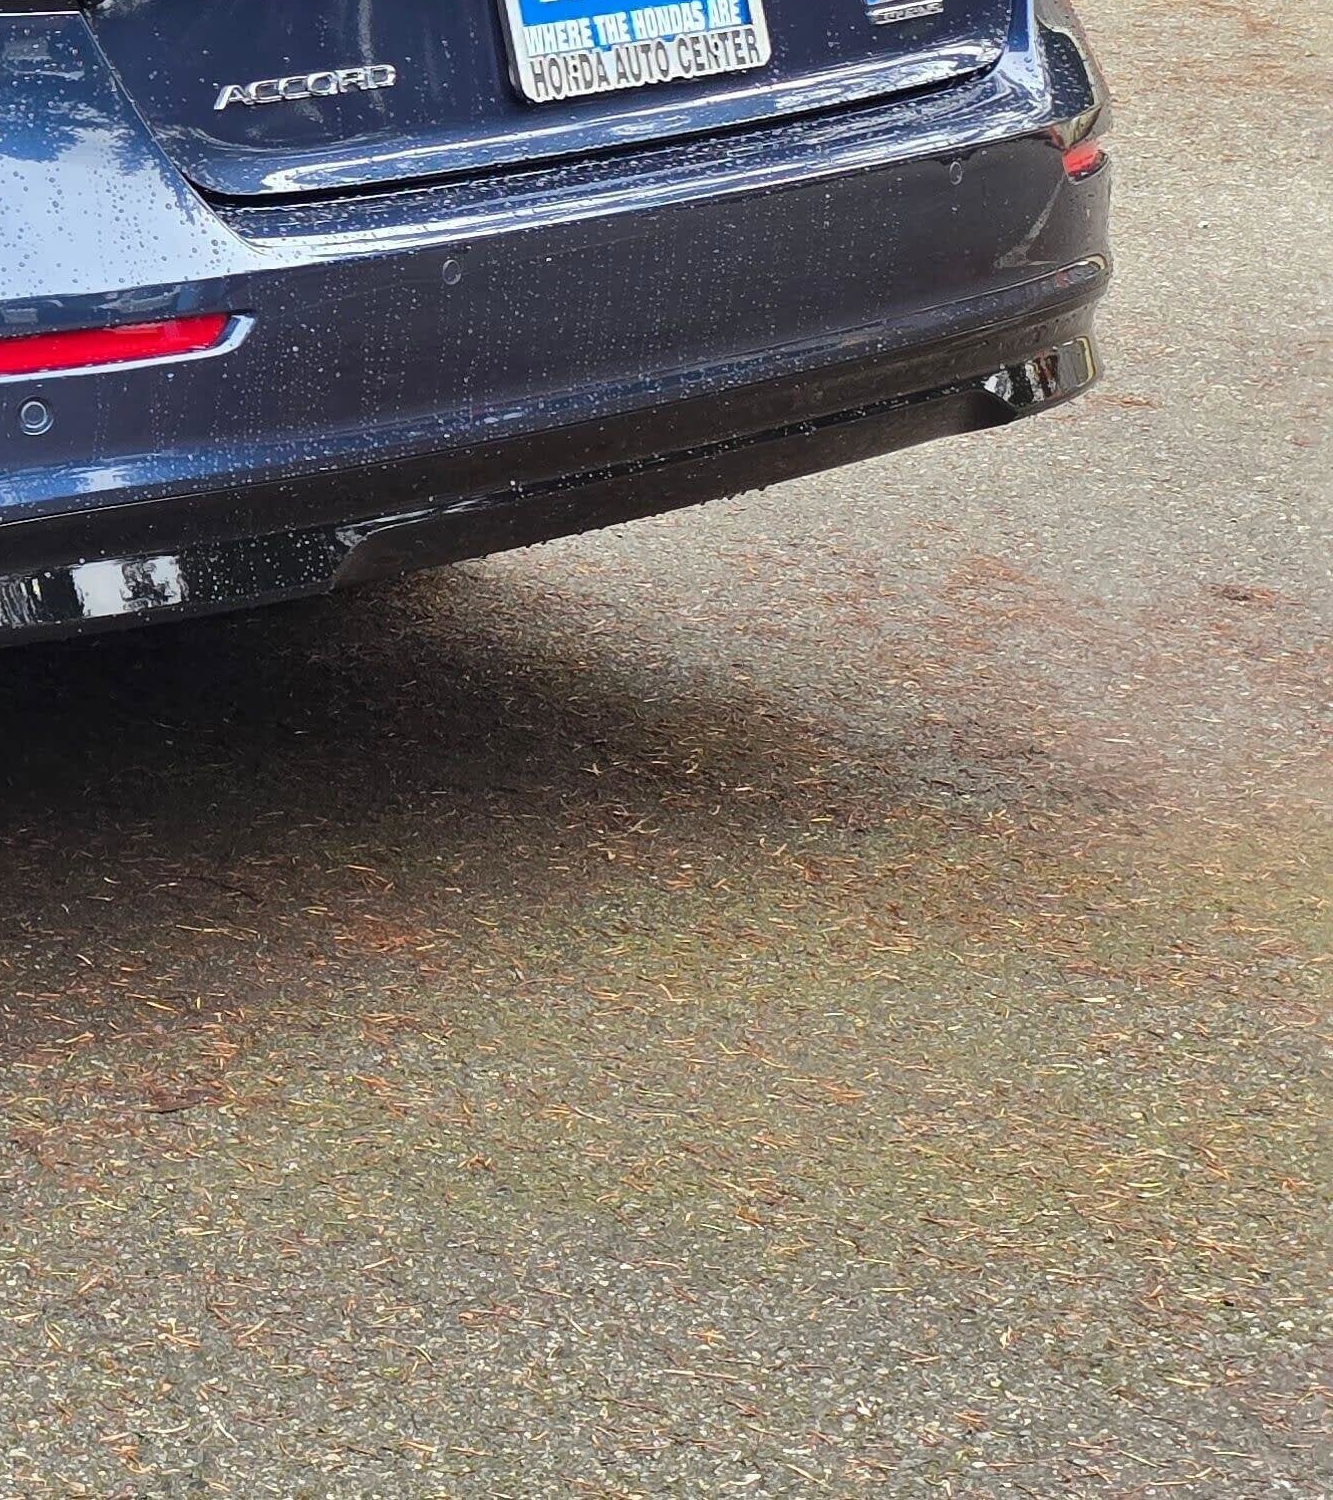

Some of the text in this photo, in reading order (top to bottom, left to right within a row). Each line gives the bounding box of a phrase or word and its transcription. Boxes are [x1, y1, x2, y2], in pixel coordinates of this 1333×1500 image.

[523, 17, 595, 56] WHERE
[593, 11, 631, 46] THE
[630, 0, 706, 41] HONDAS
[213, 64, 397, 110] ACCORD
[529, 28, 761, 98] HONDA AUTO CENTER
